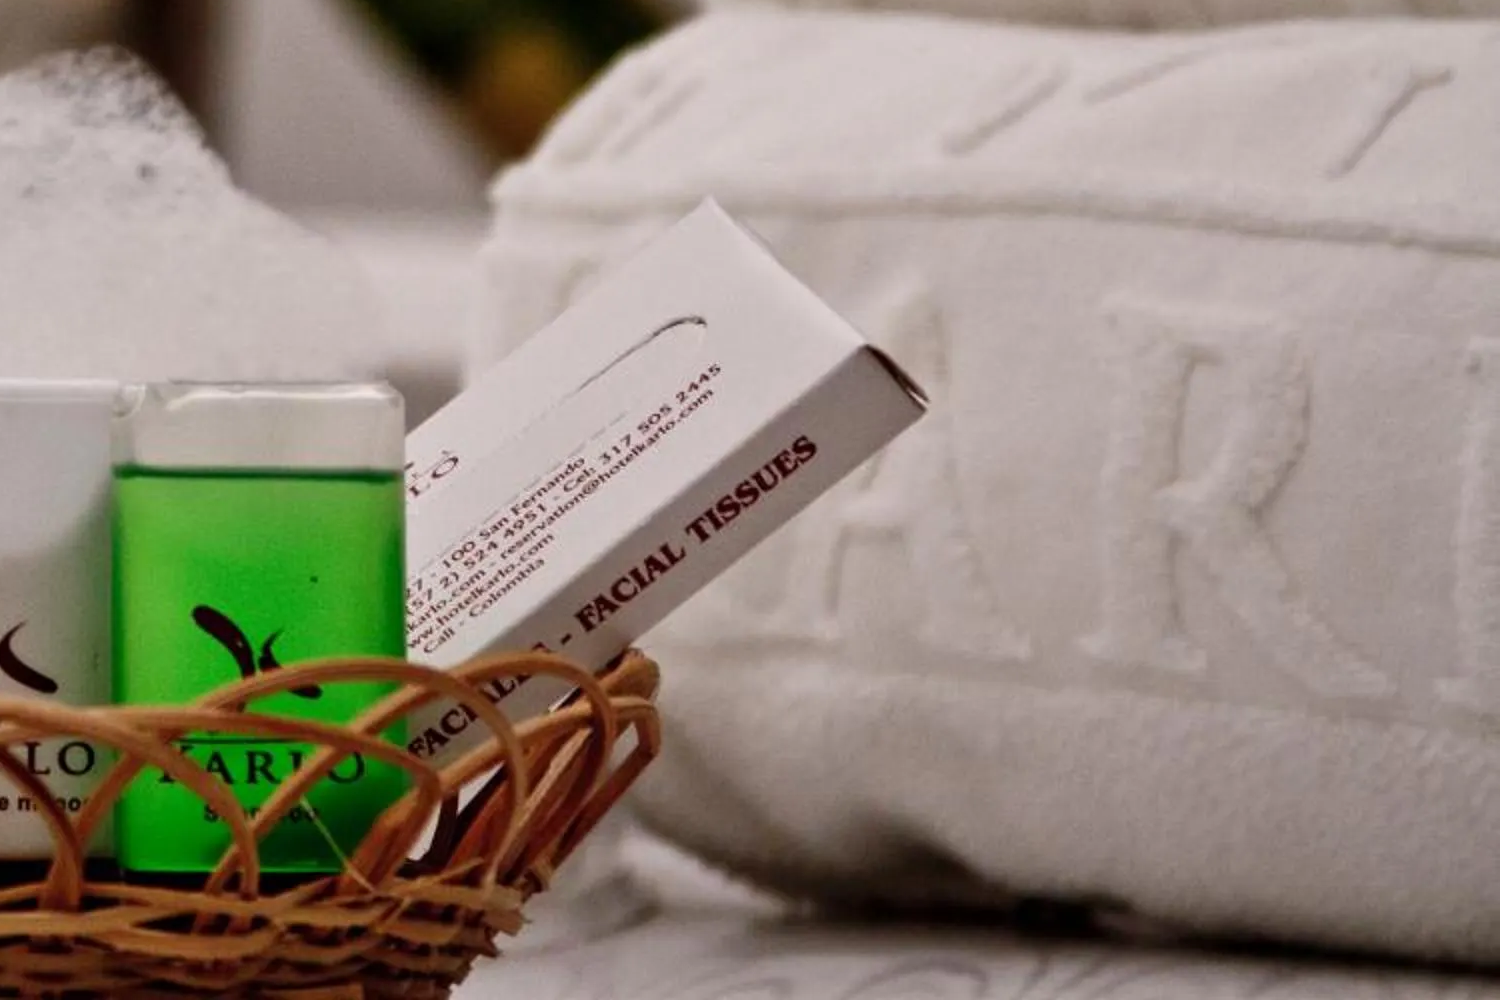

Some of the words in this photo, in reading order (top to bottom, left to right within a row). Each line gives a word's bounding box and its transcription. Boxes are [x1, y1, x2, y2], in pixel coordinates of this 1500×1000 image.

[442, 541, 476, 569] 100
[479, 516, 509, 540] San
[510, 457, 585, 517] Fernando
[463, 540, 499, 570] 524
[503, 503, 547, 540] 4951
[600, 433, 632, 466] 317
[636, 403, 672, 435] 505
[675, 363, 722, 405] 2445
[499, 389, 714, 560] reservation@hotelkarlo.com
[574, 543, 687, 633] FACIAL
[684, 434, 819, 544] TISSUES
[423, 627, 456, 654] Cali
[468, 558, 546, 618] Colombia
